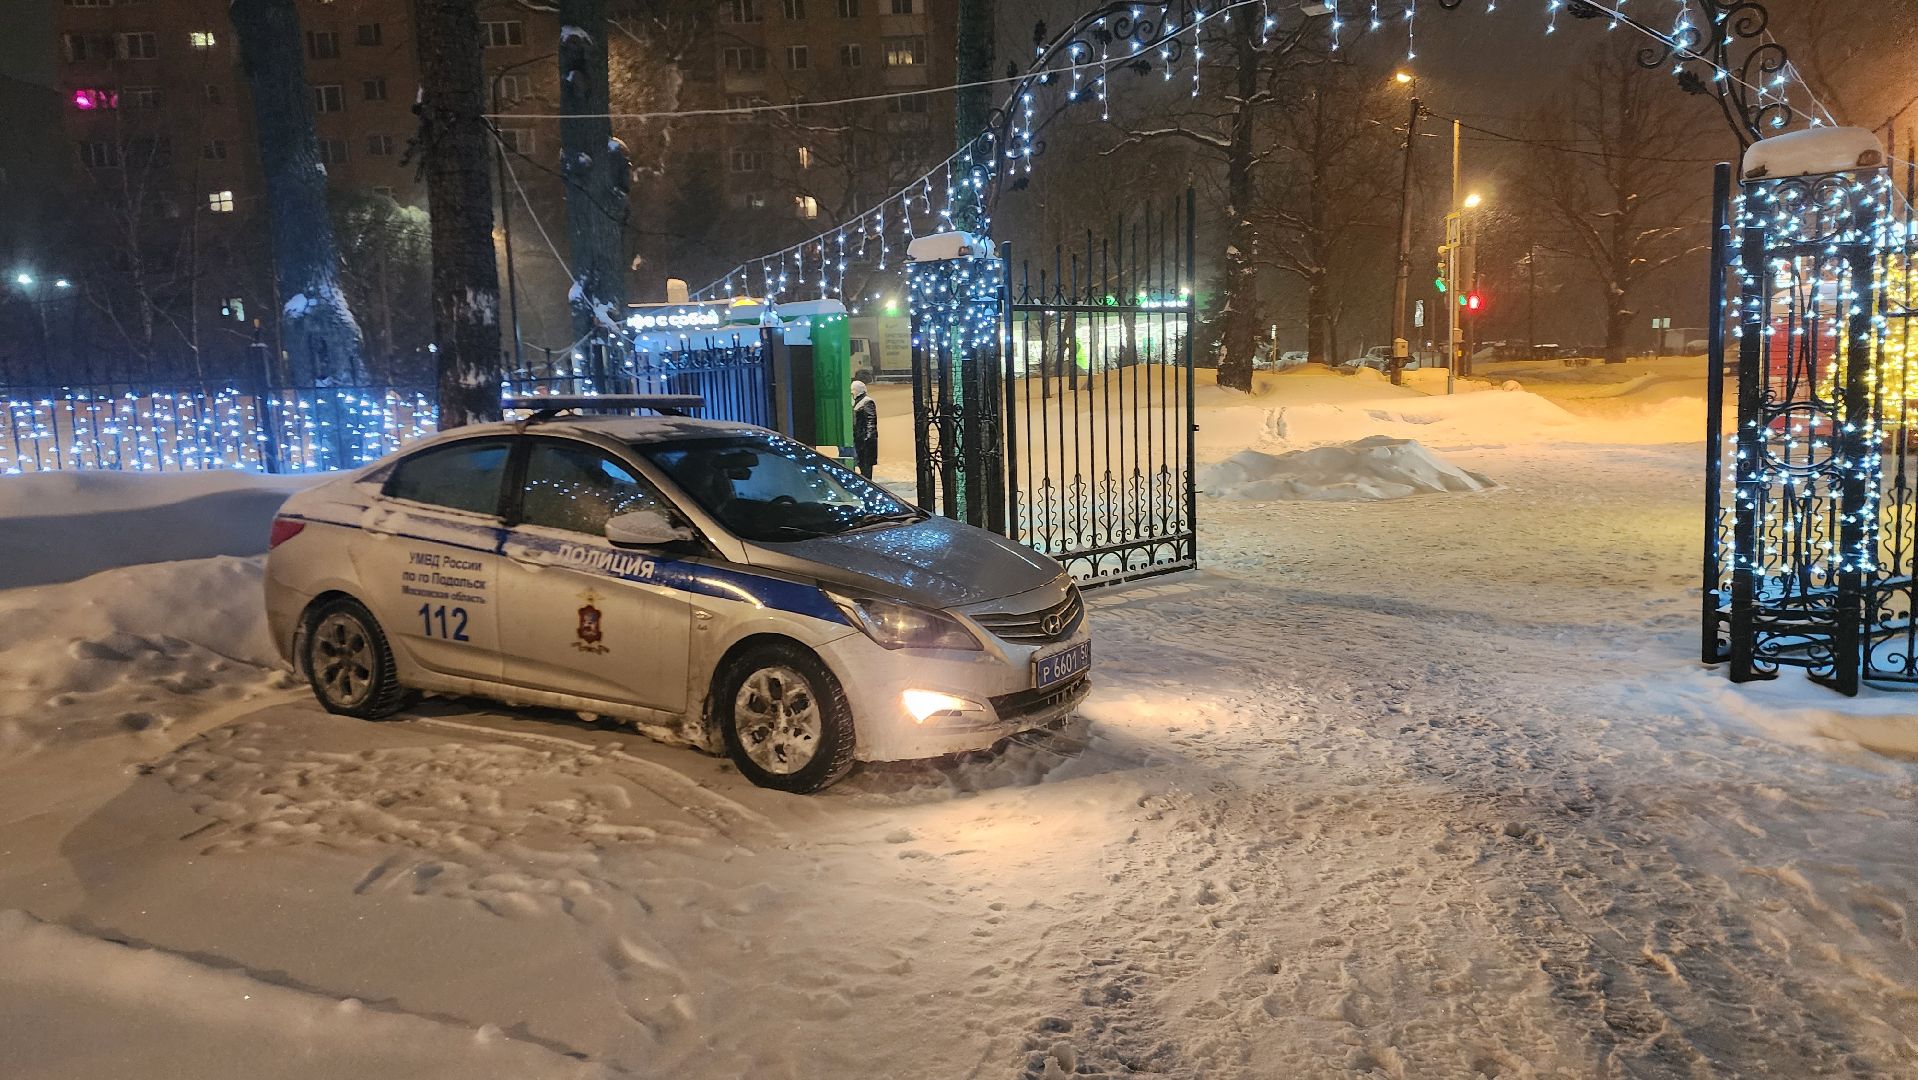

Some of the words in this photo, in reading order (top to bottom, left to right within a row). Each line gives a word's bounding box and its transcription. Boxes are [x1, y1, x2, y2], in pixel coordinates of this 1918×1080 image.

[408, 552, 440, 569] УМВД
[443, 555, 482, 571] России
[560, 543, 655, 579] ПОЛИЦИЯ
[402, 571, 416, 582] по
[418, 573, 430, 583] го
[431, 572, 487, 590] Подольск
[418, 602, 470, 641] 112
[1054, 650, 1077, 678] 6601
